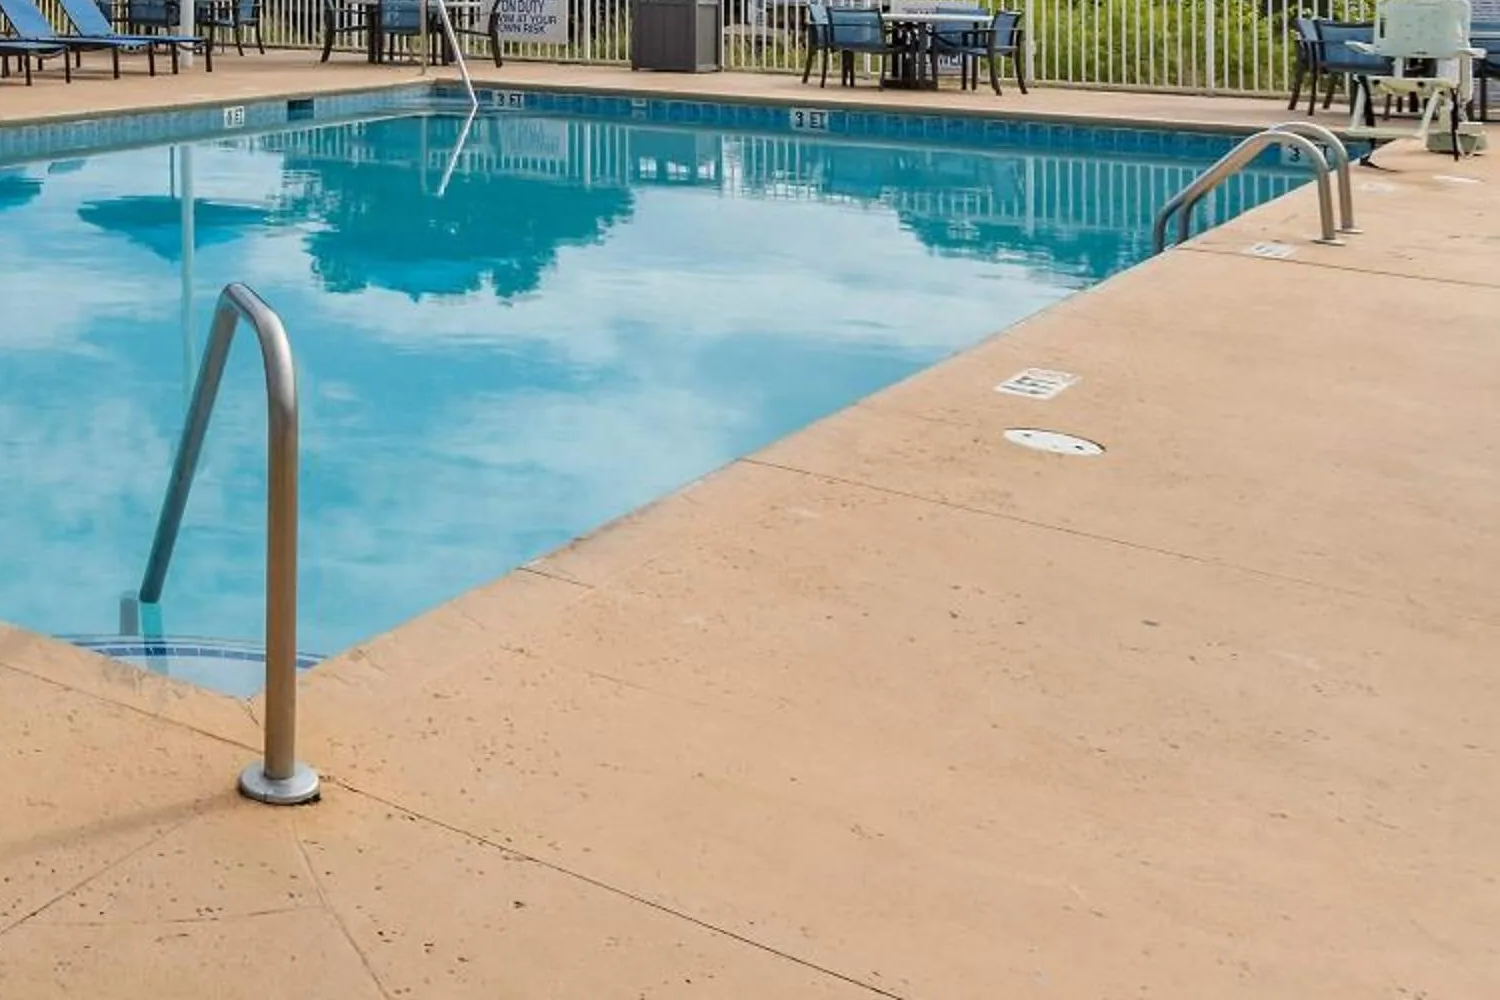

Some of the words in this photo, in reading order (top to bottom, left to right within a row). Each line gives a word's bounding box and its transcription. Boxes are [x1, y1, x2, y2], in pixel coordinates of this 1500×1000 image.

[501, 0, 517, 13] ON
[518, 0, 544, 14] DUTY
[524, 23, 548, 34] RISK
[497, 93, 505, 107] 3
[510, 93, 522, 108] FT
[1288, 143, 1300, 162] 3
